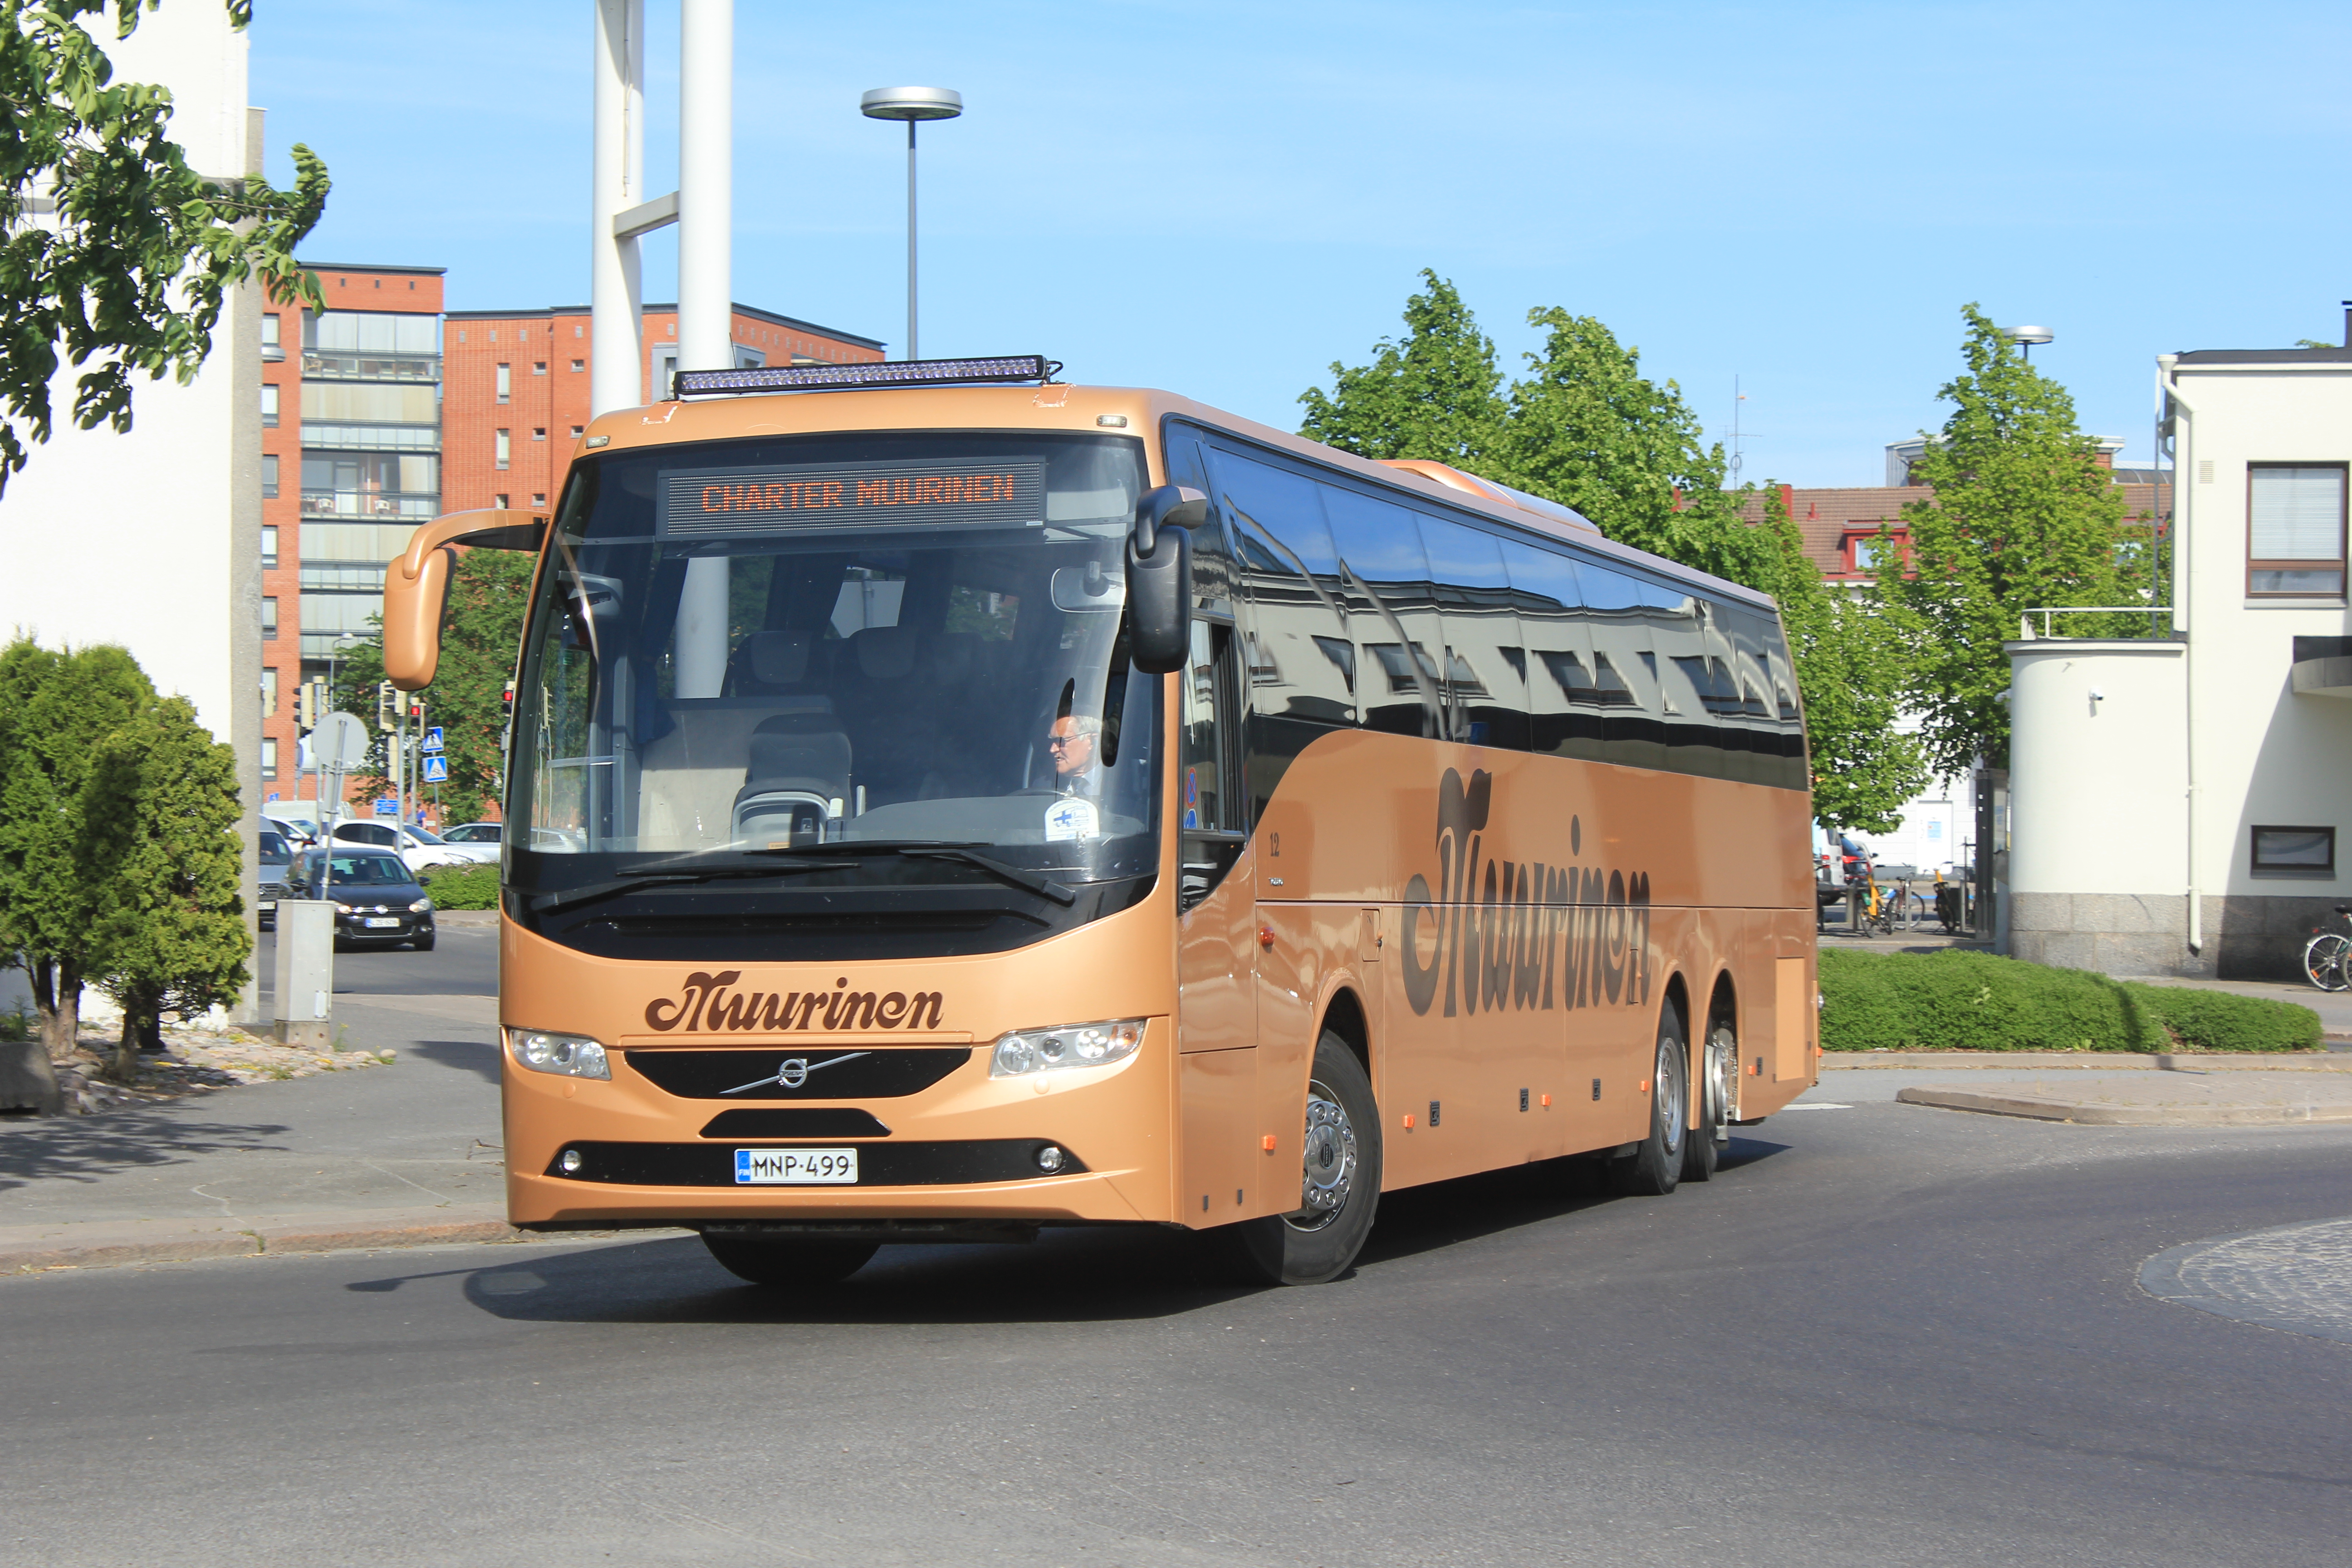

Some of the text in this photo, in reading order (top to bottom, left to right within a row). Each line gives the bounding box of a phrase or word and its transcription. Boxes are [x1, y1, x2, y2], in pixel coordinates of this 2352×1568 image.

[702, 474, 1014, 512] CHARTER MUURINEN
[1270, 832, 1279, 857] 12
[1401, 767, 1651, 1018] Muurinen
[645, 970, 945, 1032] Muurinen
[754, 1155, 850, 1177] MNP-499
